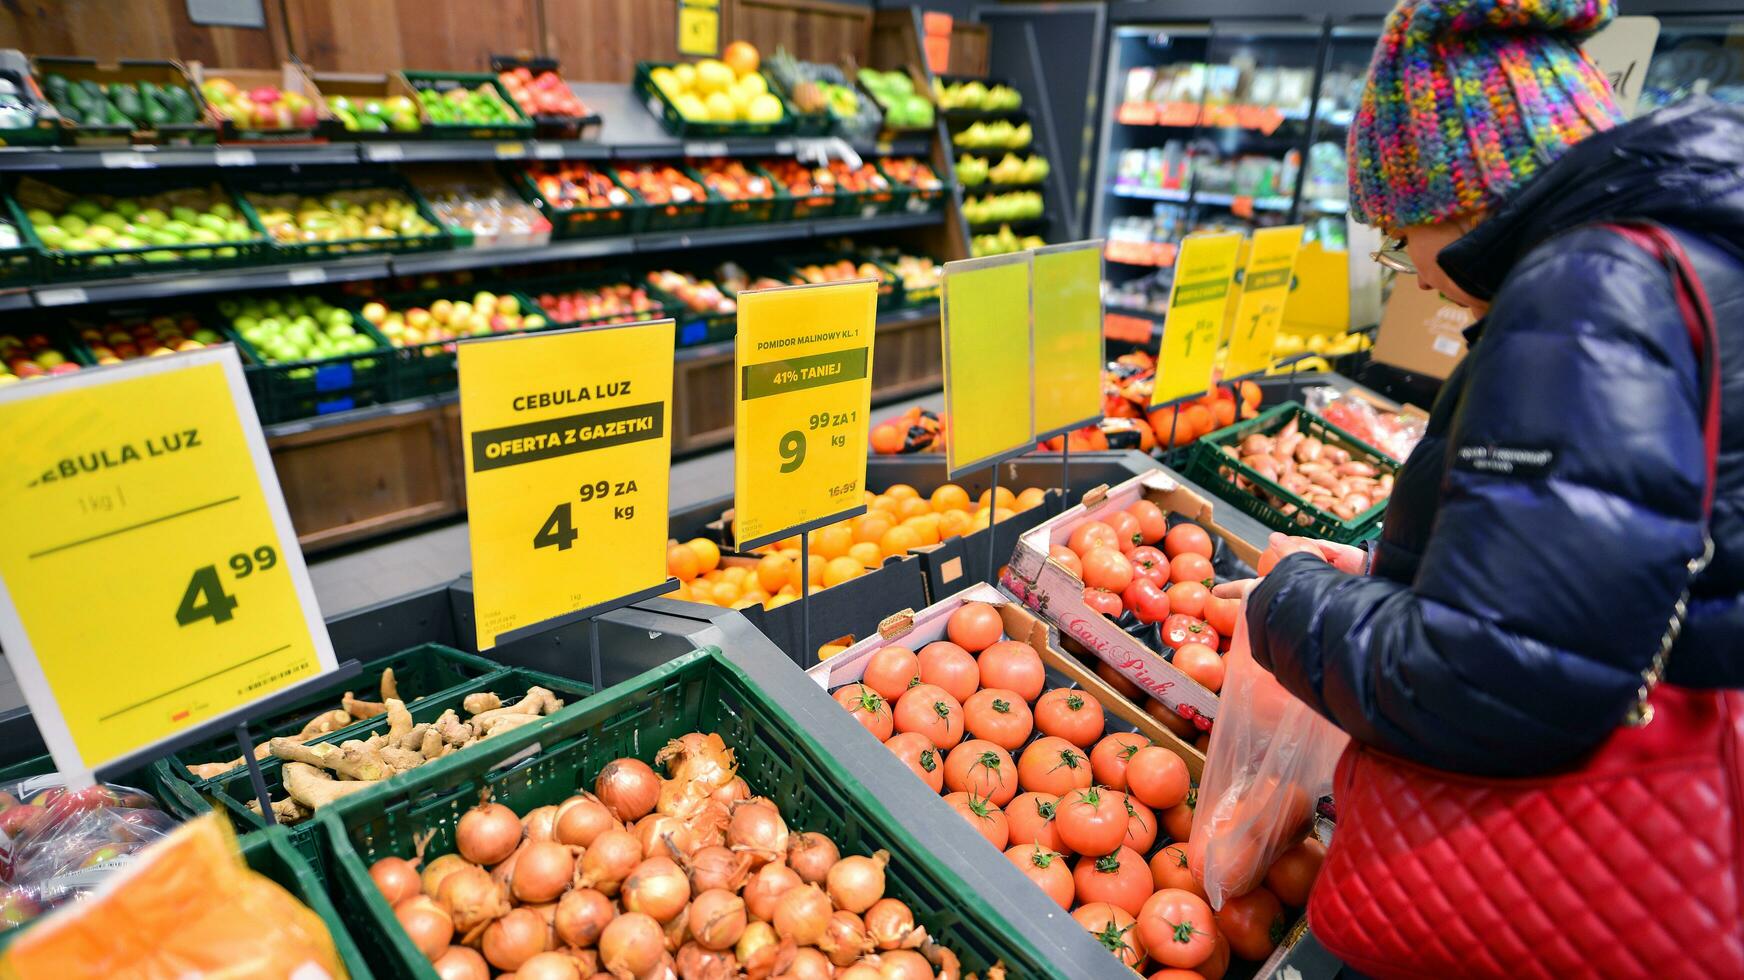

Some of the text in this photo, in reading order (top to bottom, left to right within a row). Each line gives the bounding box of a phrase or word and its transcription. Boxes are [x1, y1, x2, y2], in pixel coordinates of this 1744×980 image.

[757, 338, 796, 350] POMIDOR
[797, 331, 841, 345] MALINOWY
[842, 330, 853, 338] KL.
[773, 362, 841, 385] 41% TANIEJ
[512, 381, 632, 412] CEBULA LUZ
[146, 429, 202, 457] LUZ
[485, 416, 653, 459] OFERTA Z GAZETKI
[779, 411, 856, 473] 9 99 ZA 1
[831, 434, 846, 447] kg
[533, 480, 638, 551] 4 99 ZA
[614, 505, 634, 520] kg
[175, 545, 277, 627] 4 99
[1109, 646, 1175, 696] Pink
